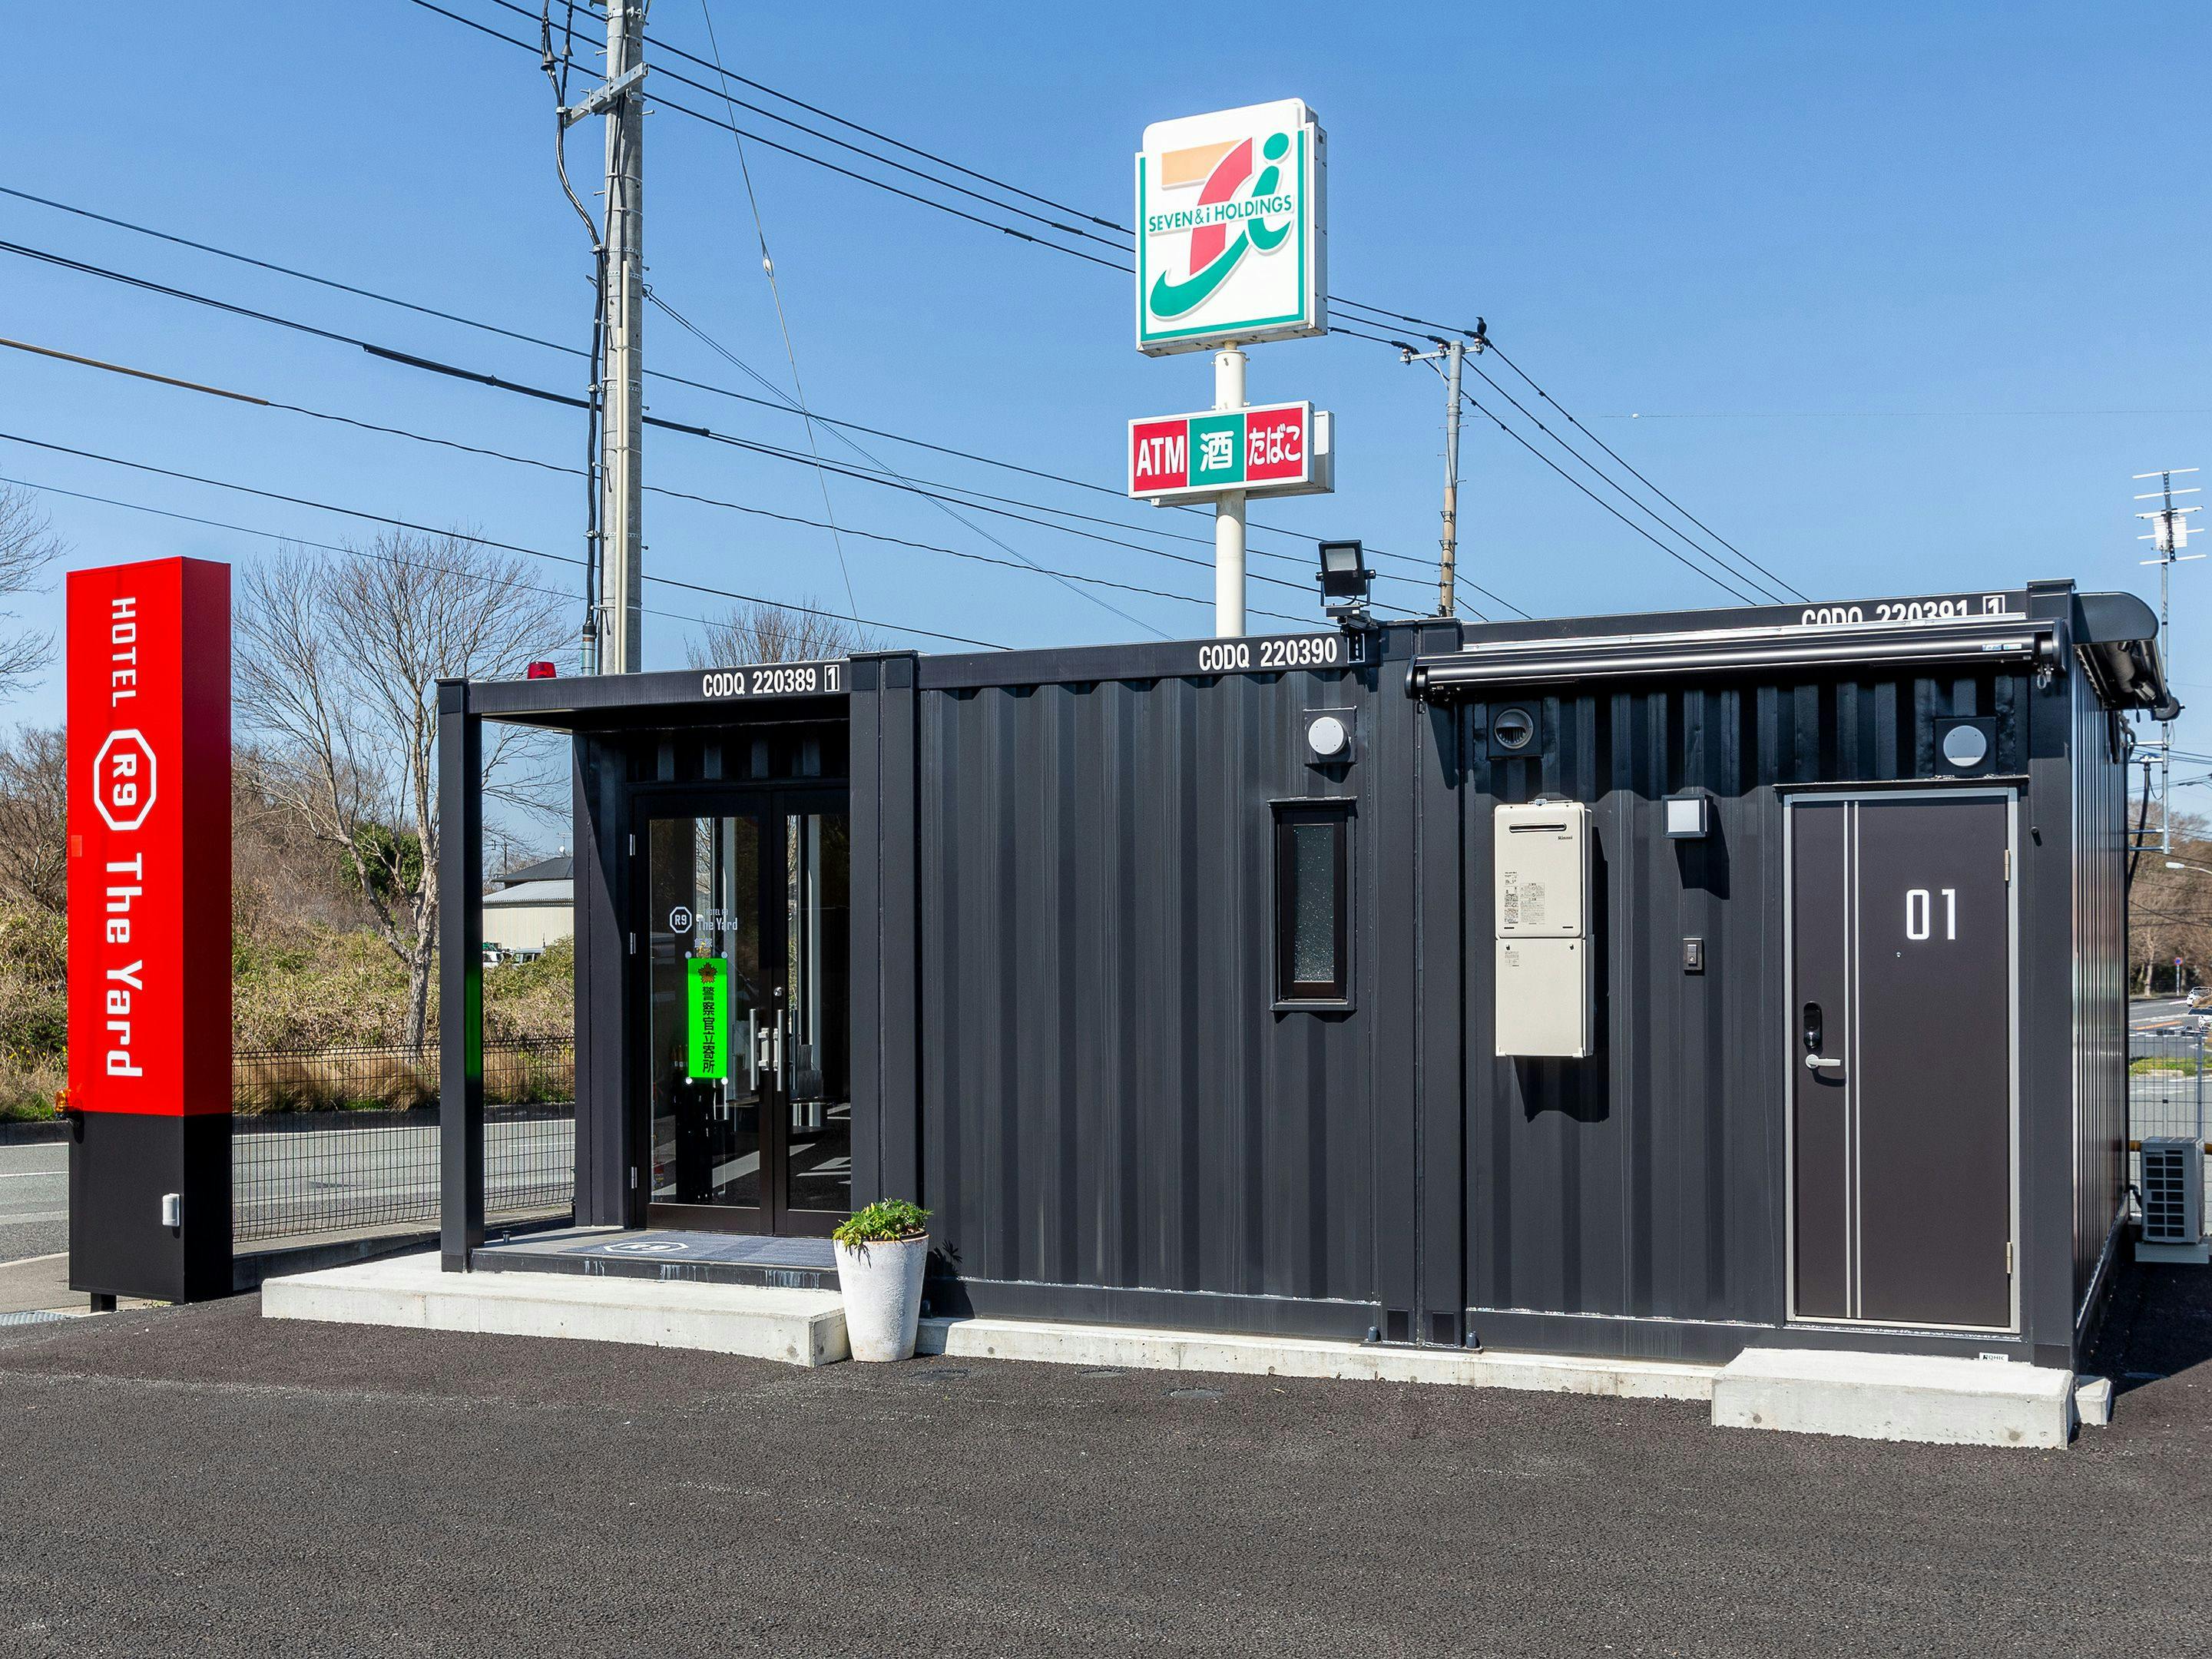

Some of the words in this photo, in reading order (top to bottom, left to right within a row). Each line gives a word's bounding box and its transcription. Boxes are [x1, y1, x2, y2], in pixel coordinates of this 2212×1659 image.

[1215, 194, 1292, 221] HOLDINGS
[1136, 435, 1185, 477] ATM
[1200, 430, 1234, 472] 酒
[1248, 423, 1301, 467] たばこ
[1876, 599, 1968, 621] 220391
[112, 597, 136, 707] HOTEL
[1199, 643, 1250, 671] CODQ
[1260, 637, 1337, 667] 220390
[703, 671, 745, 697] CODQ
[752, 667, 816, 694] 220389
[112, 753, 137, 806] R9
[106, 852, 143, 944] The
[1906, 889, 1955, 940] 01
[674, 914, 687, 926] R9
[698, 917, 714, 930] The
[715, 917, 737, 931] Yard
[107, 959, 143, 1077] Yard
[702, 986, 715, 1074] 警察官立寄所
